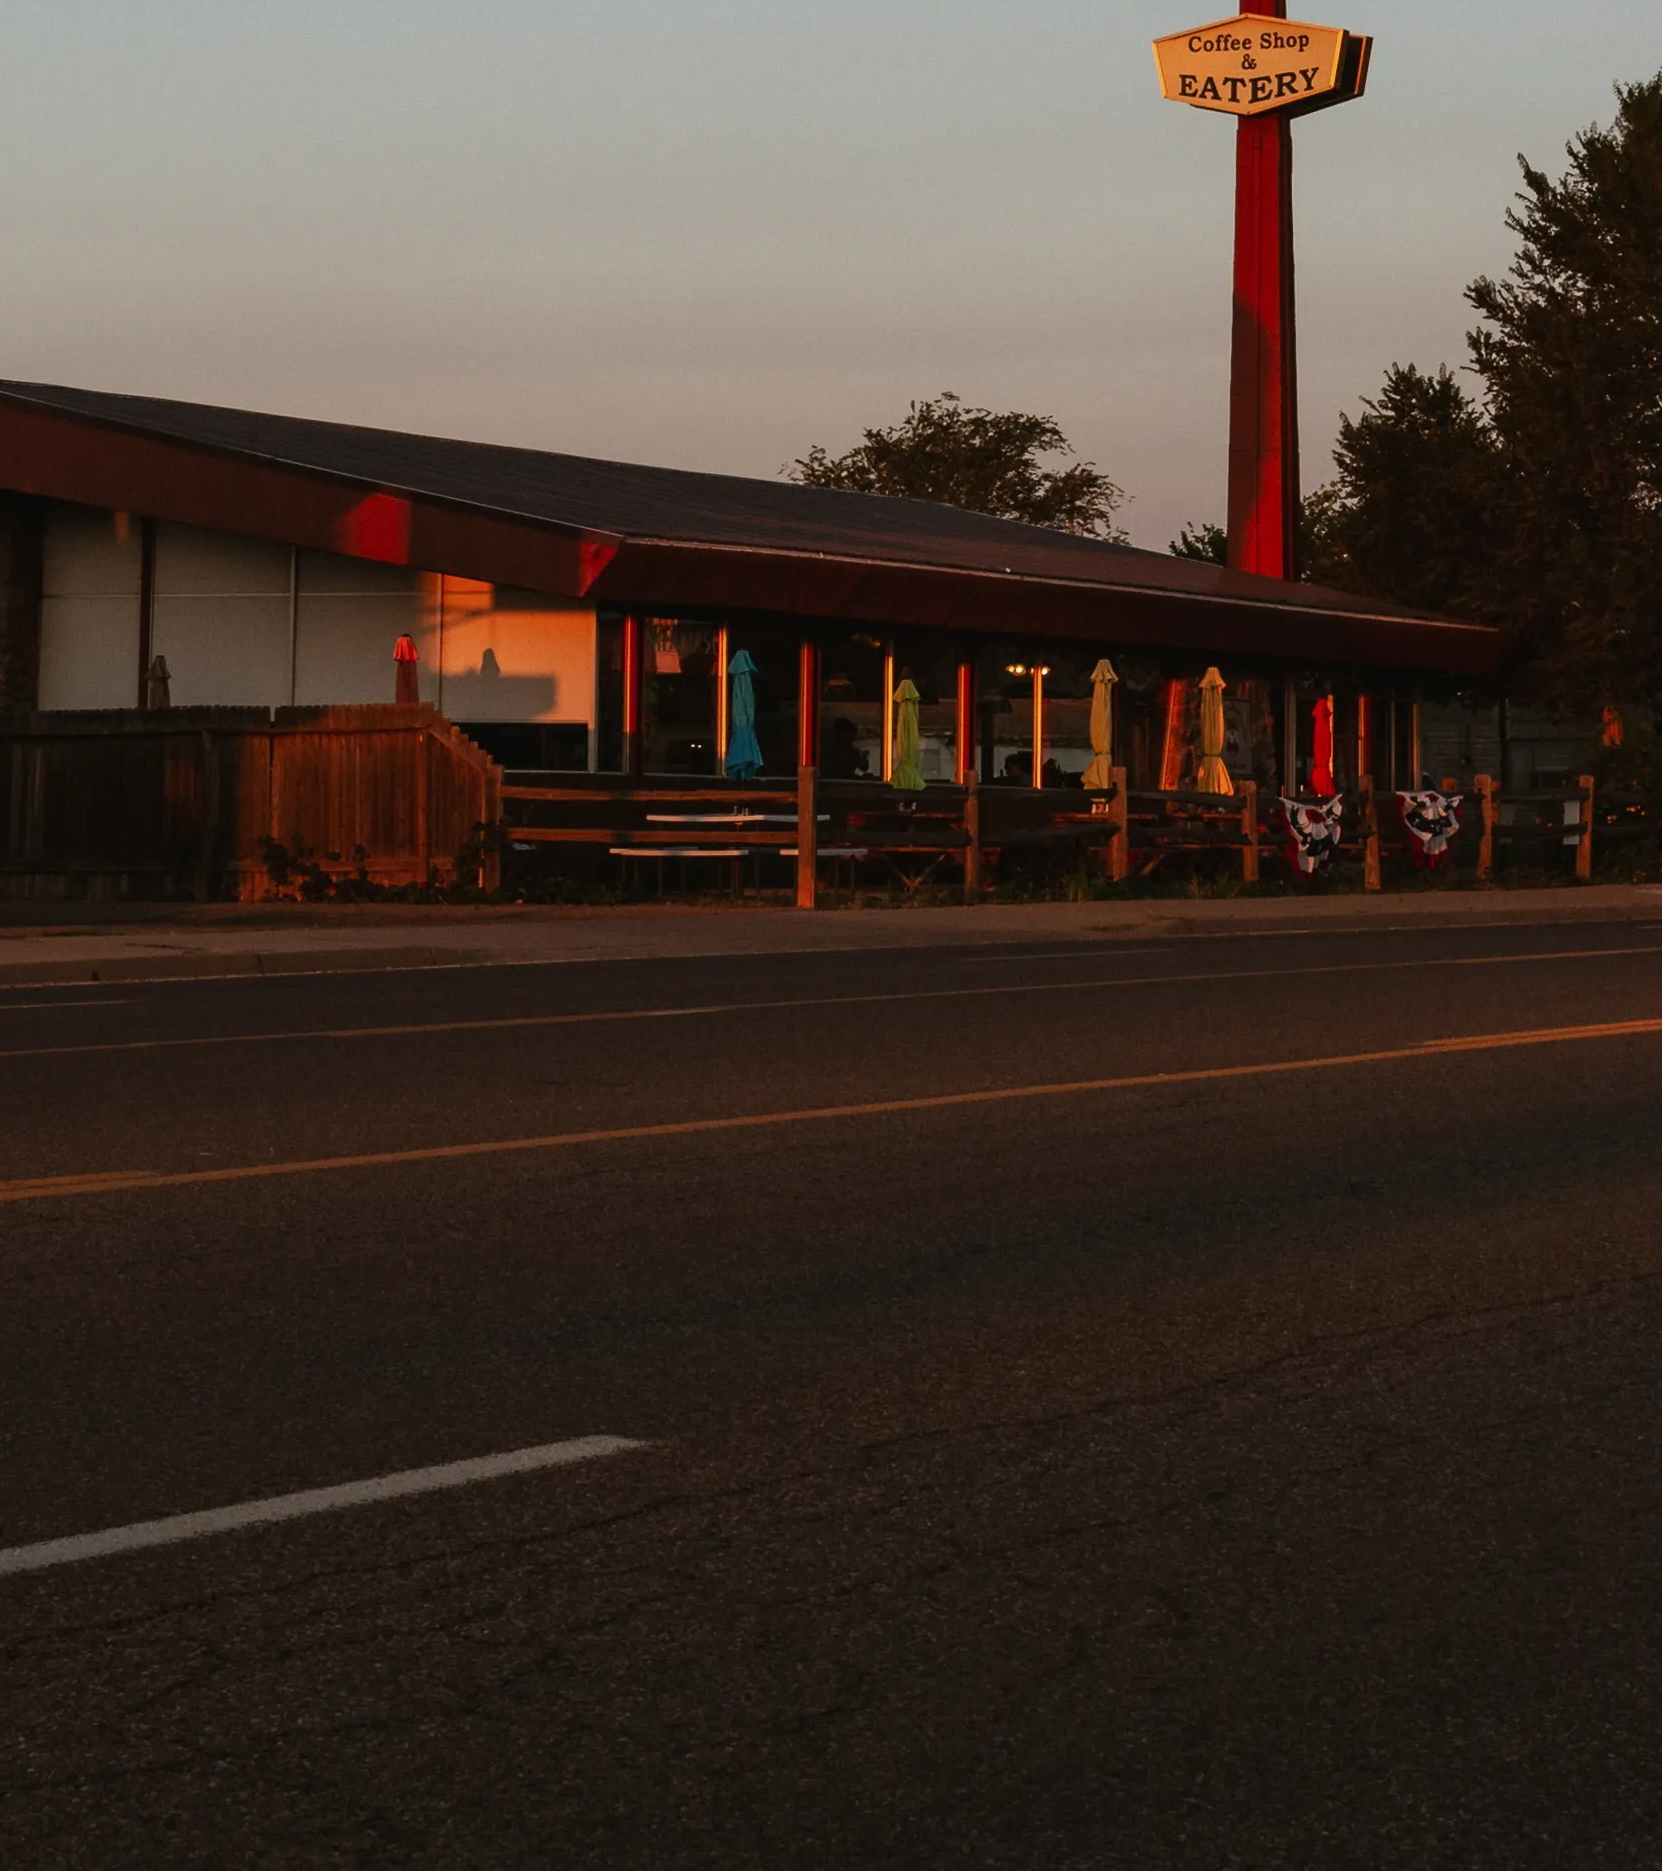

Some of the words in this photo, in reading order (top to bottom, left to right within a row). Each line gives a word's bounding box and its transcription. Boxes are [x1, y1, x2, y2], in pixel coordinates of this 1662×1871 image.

[1188, 34, 1252, 52] Coffee
[1260, 32, 1310, 52] Shop
[1241, 53, 1257, 70] &
[1178, 67, 1320, 104] EATERY
